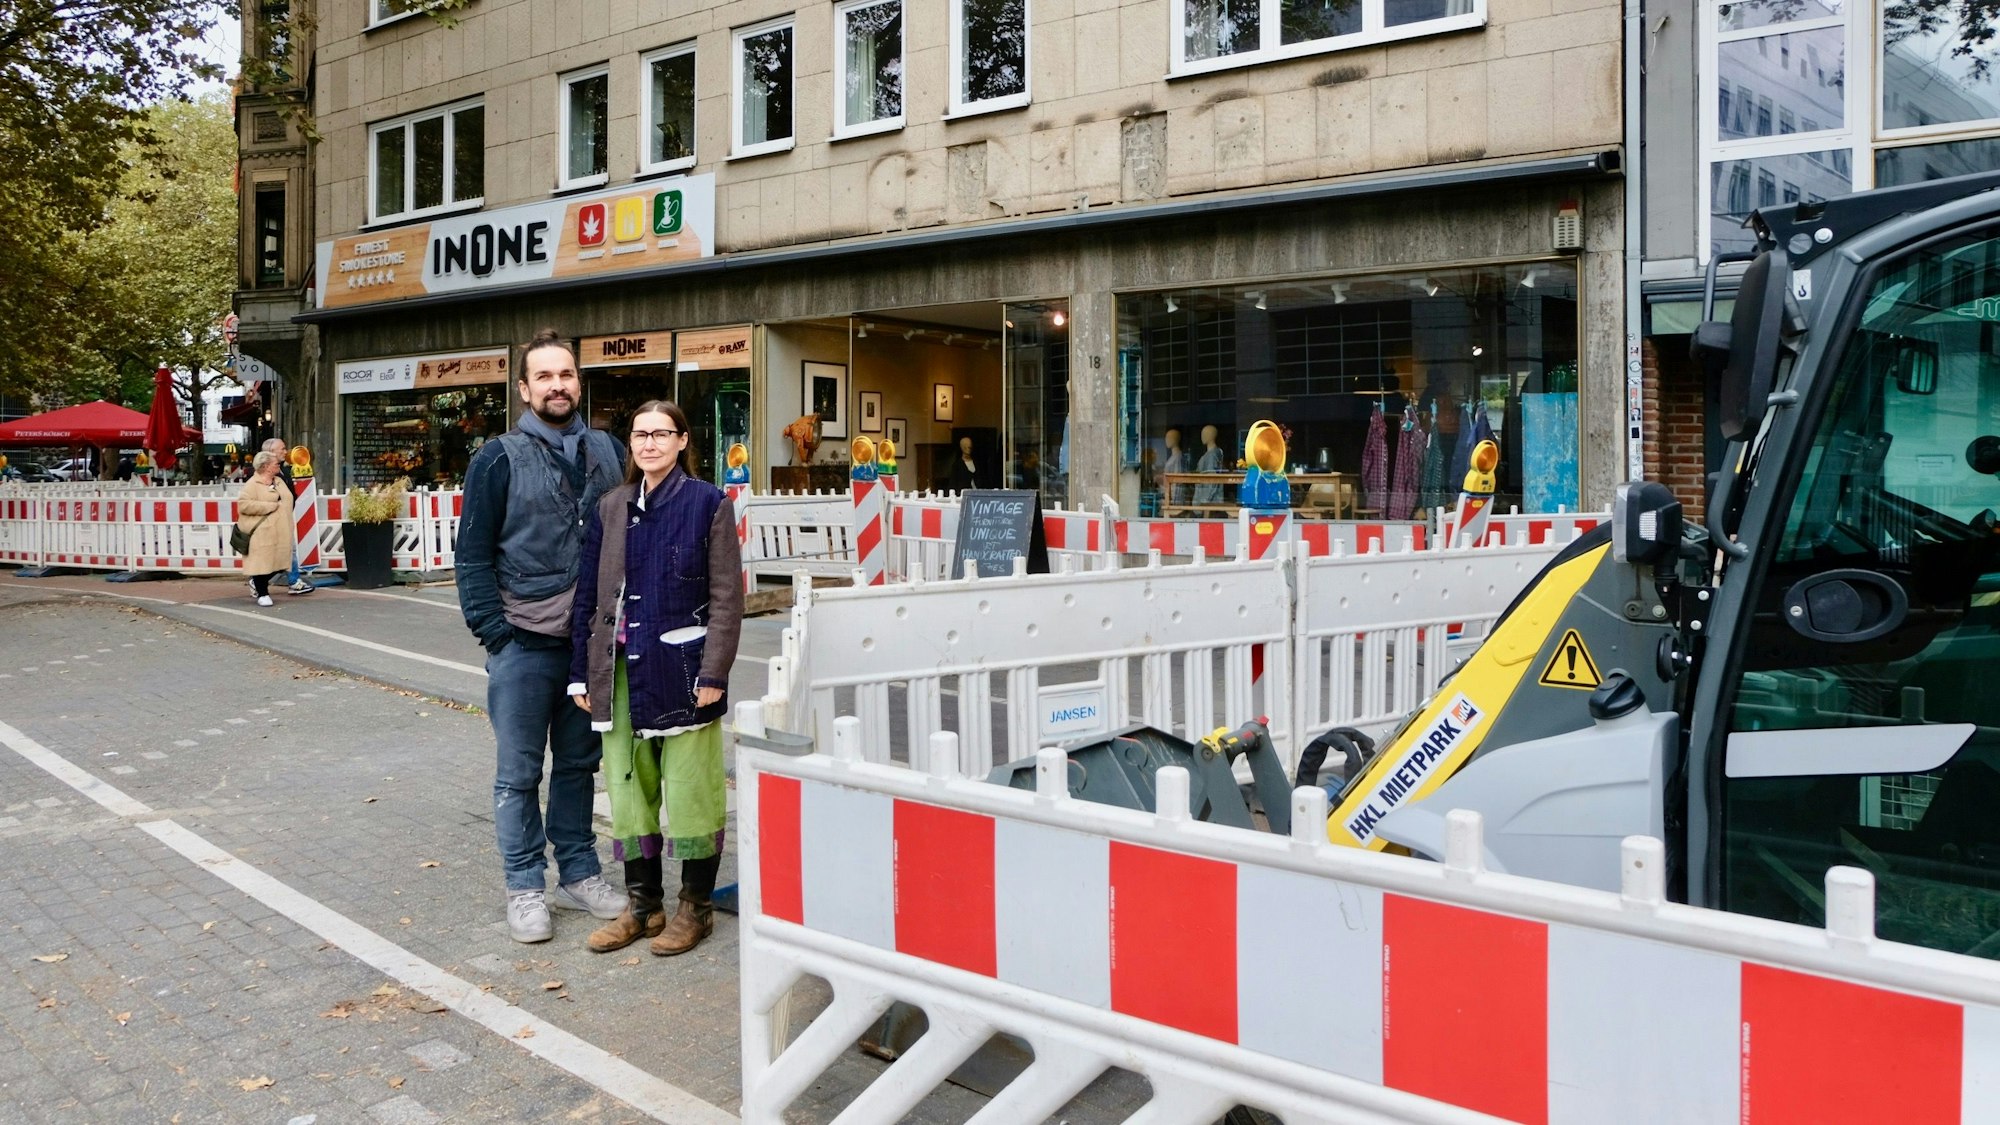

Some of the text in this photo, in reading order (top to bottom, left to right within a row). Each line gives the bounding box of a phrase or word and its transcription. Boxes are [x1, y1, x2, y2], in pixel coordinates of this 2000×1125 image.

[339, 251, 406, 273] SMOKESTORE
[726, 340, 747, 353] RAW
[1090, 355, 1101, 369] 18
[971, 500, 1024, 515] VINTAGE
[970, 528, 1017, 540] UNIQUE
[1050, 705, 1096, 723] JANSEN
[1349, 717, 1462, 840] HKL MIETPARK
